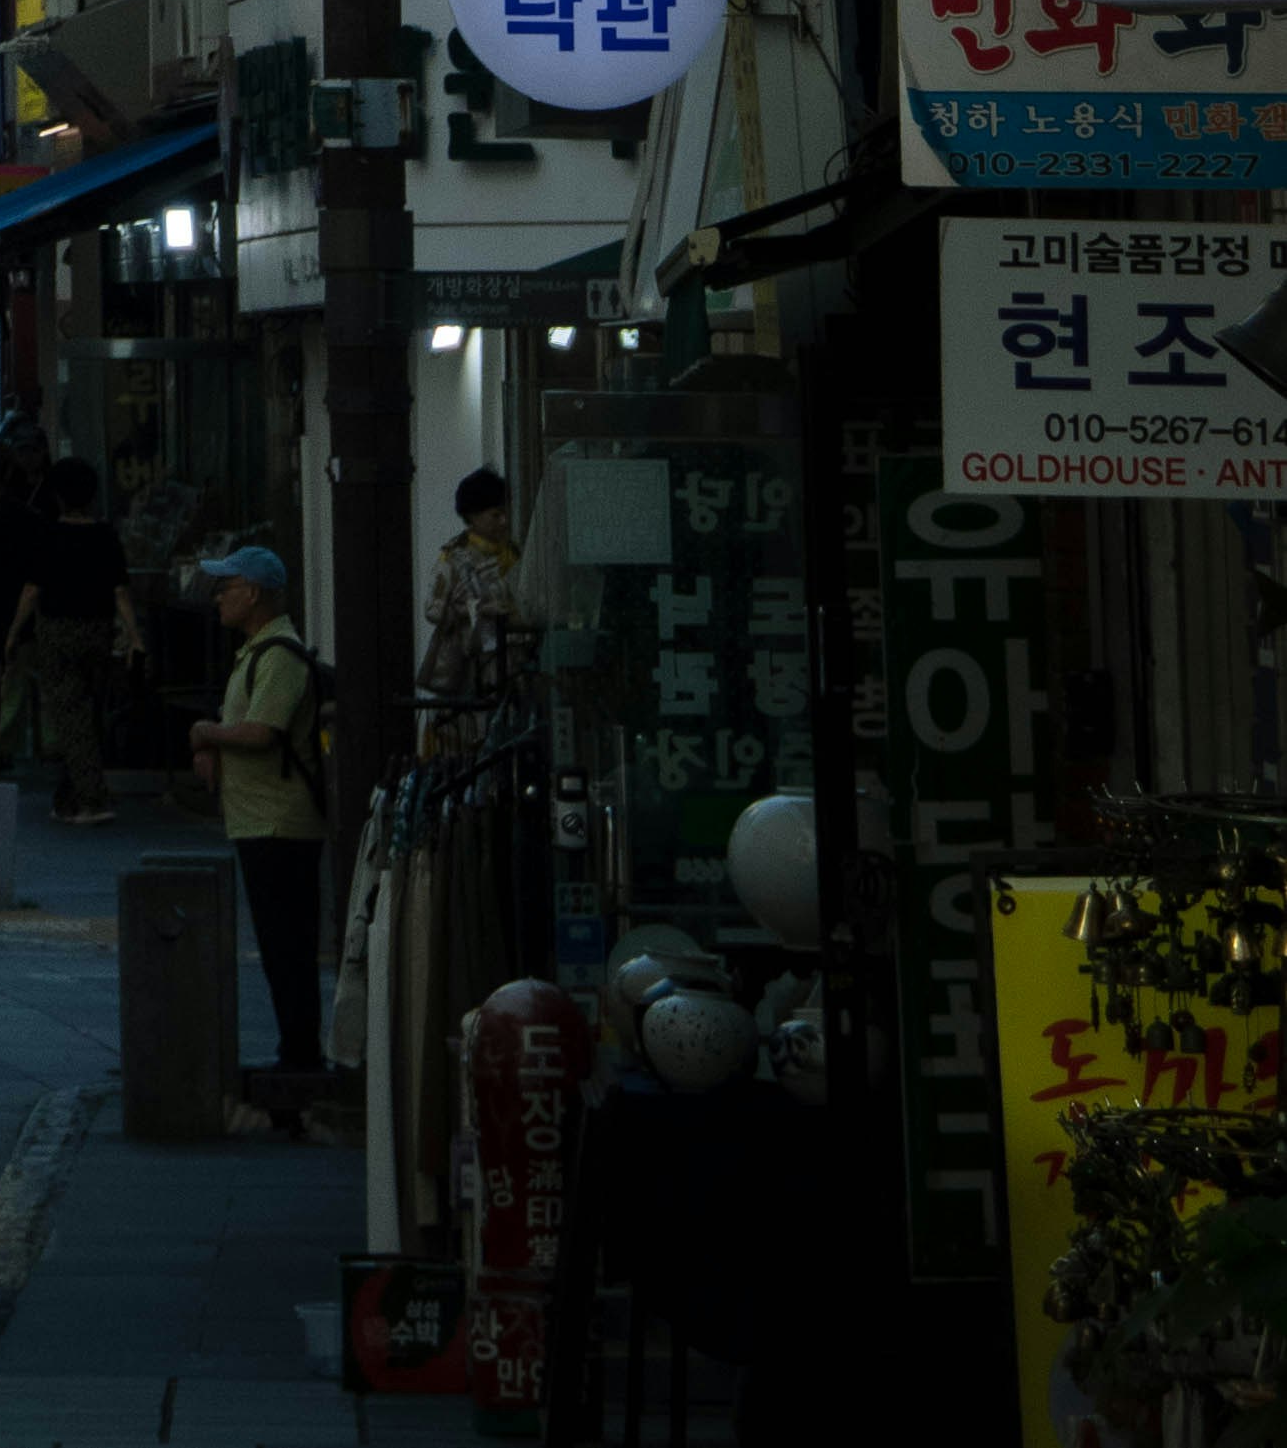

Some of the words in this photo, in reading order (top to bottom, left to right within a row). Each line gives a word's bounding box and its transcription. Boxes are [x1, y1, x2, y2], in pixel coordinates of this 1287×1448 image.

[928, 101, 1005, 141] 청하
[1024, 101, 1145, 141] 노용식
[1162, 102, 1246, 142] 민화
[949, 151, 1262, 181] 010-2331-2227
[999, 233, 1250, 276] 고미술품감정
[426, 275, 522, 300] 개방화장실
[962, 452, 1188, 485] GOLDHOUSE
[519, 1024, 566, 1152] 도장
